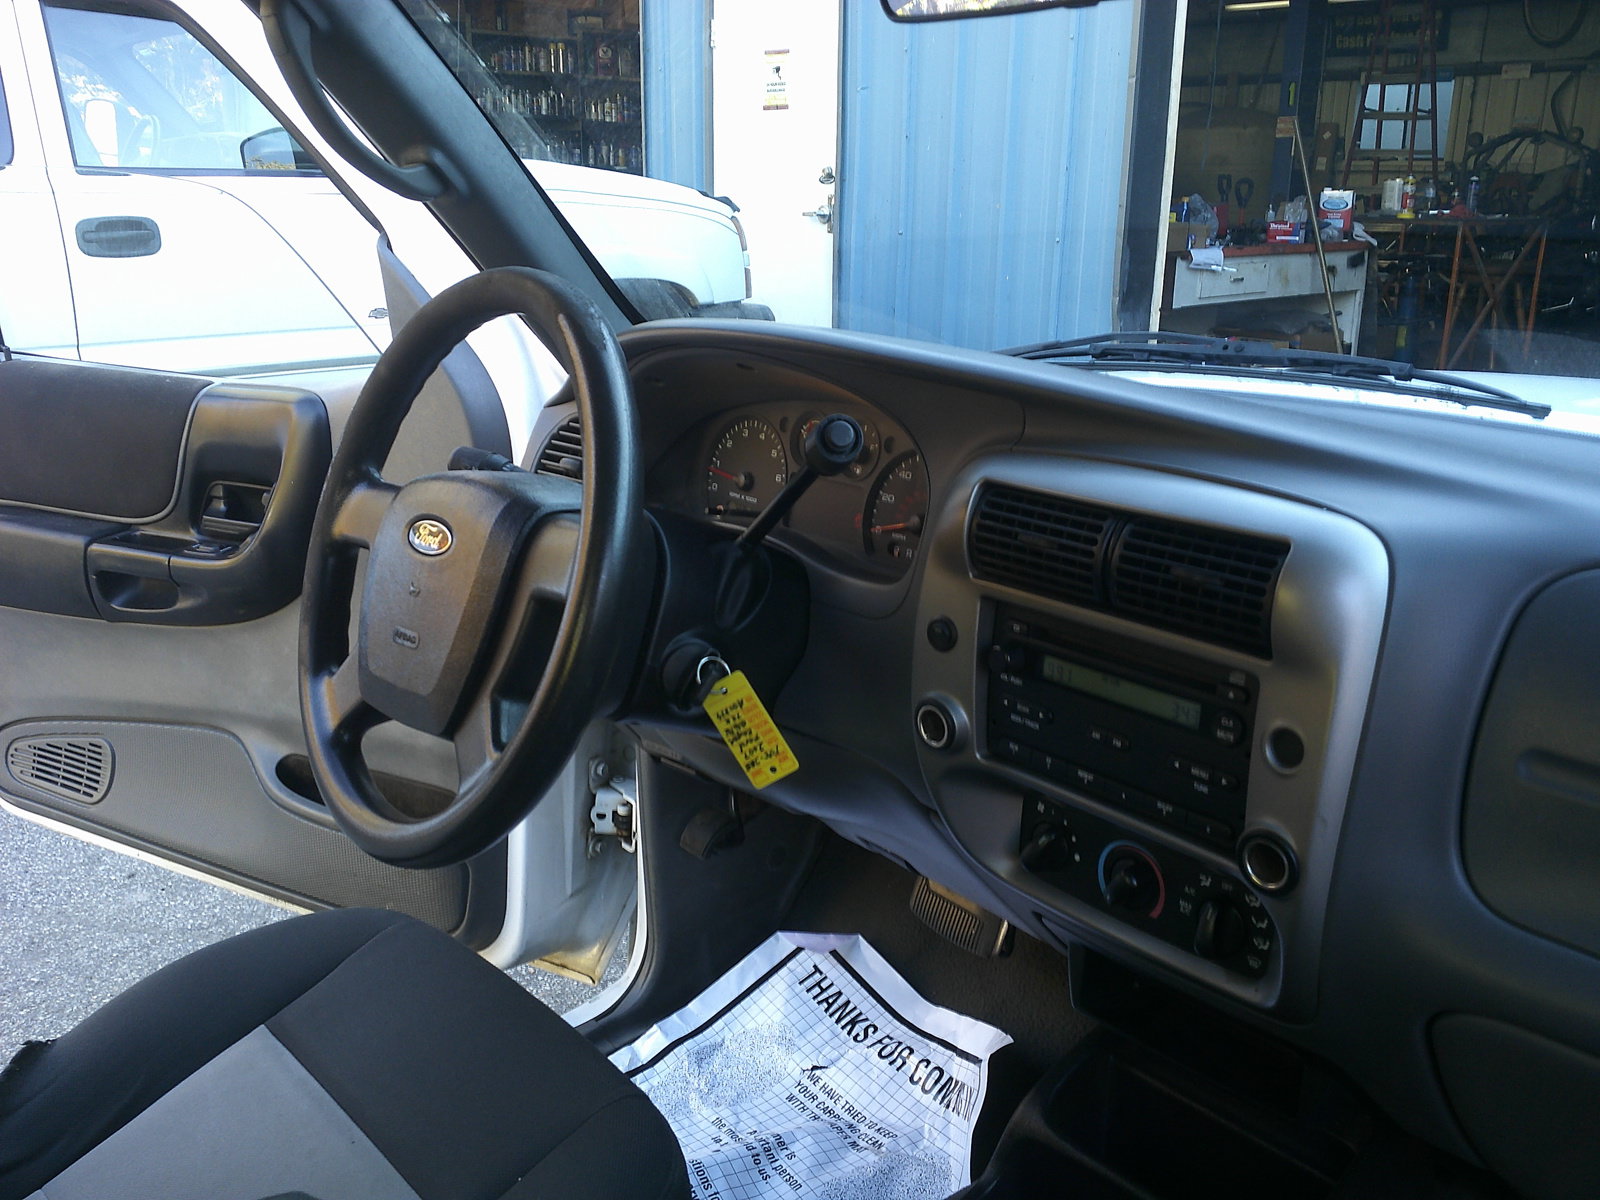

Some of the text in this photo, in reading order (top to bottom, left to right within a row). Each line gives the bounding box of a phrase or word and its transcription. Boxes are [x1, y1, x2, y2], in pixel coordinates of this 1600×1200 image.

[742, 428, 749, 437] 3
[759, 432, 765, 440] 4
[726, 439, 733, 447] 2
[770, 449, 778, 458] 5
[775, 473, 782, 482] 6
[881, 493, 895, 503] 20
[414, 523, 443, 550] Ford
[798, 964, 878, 1044] THANKS
[866, 1034, 915, 1073] FOR
[794, 1080, 819, 1104] YOUR
[785, 1093, 810, 1113] WITH
[805, 1071, 898, 1140] WE HAVE TRIED TO KEEP
[711, 1116, 727, 1130] the
[772, 1164, 803, 1191] person
[785, 1151, 797, 1161] is
[751, 1153, 762, 1166] to
